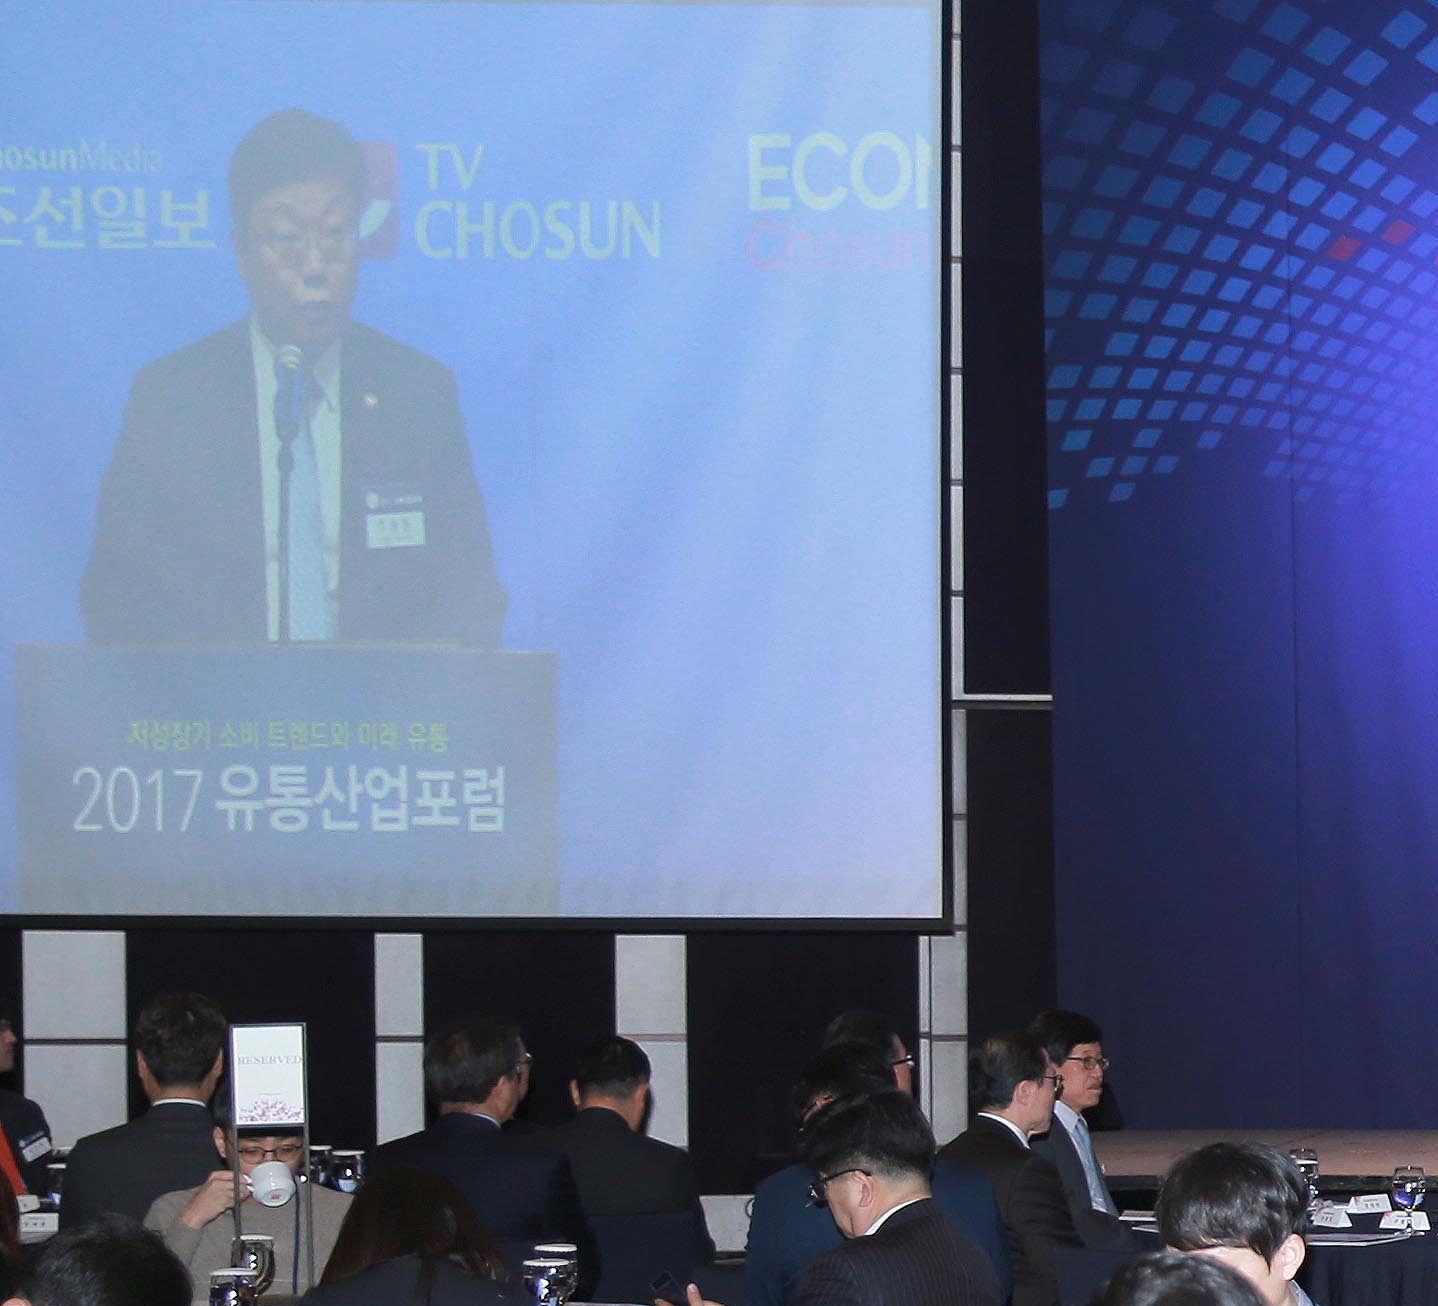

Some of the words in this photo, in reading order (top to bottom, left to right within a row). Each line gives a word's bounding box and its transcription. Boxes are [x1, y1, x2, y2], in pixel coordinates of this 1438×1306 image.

[0, 138, 165, 172] osunMedia
[415, 142, 486, 191] TV
[415, 199, 661, 260] CHOSUN
[218, 720, 262, 752] 소비
[407, 720, 450, 752] 유통
[72, 766, 203, 834] 2017
[215, 763, 506, 834] 유통산업포럼
[238, 1055, 303, 1065] RESERVED
